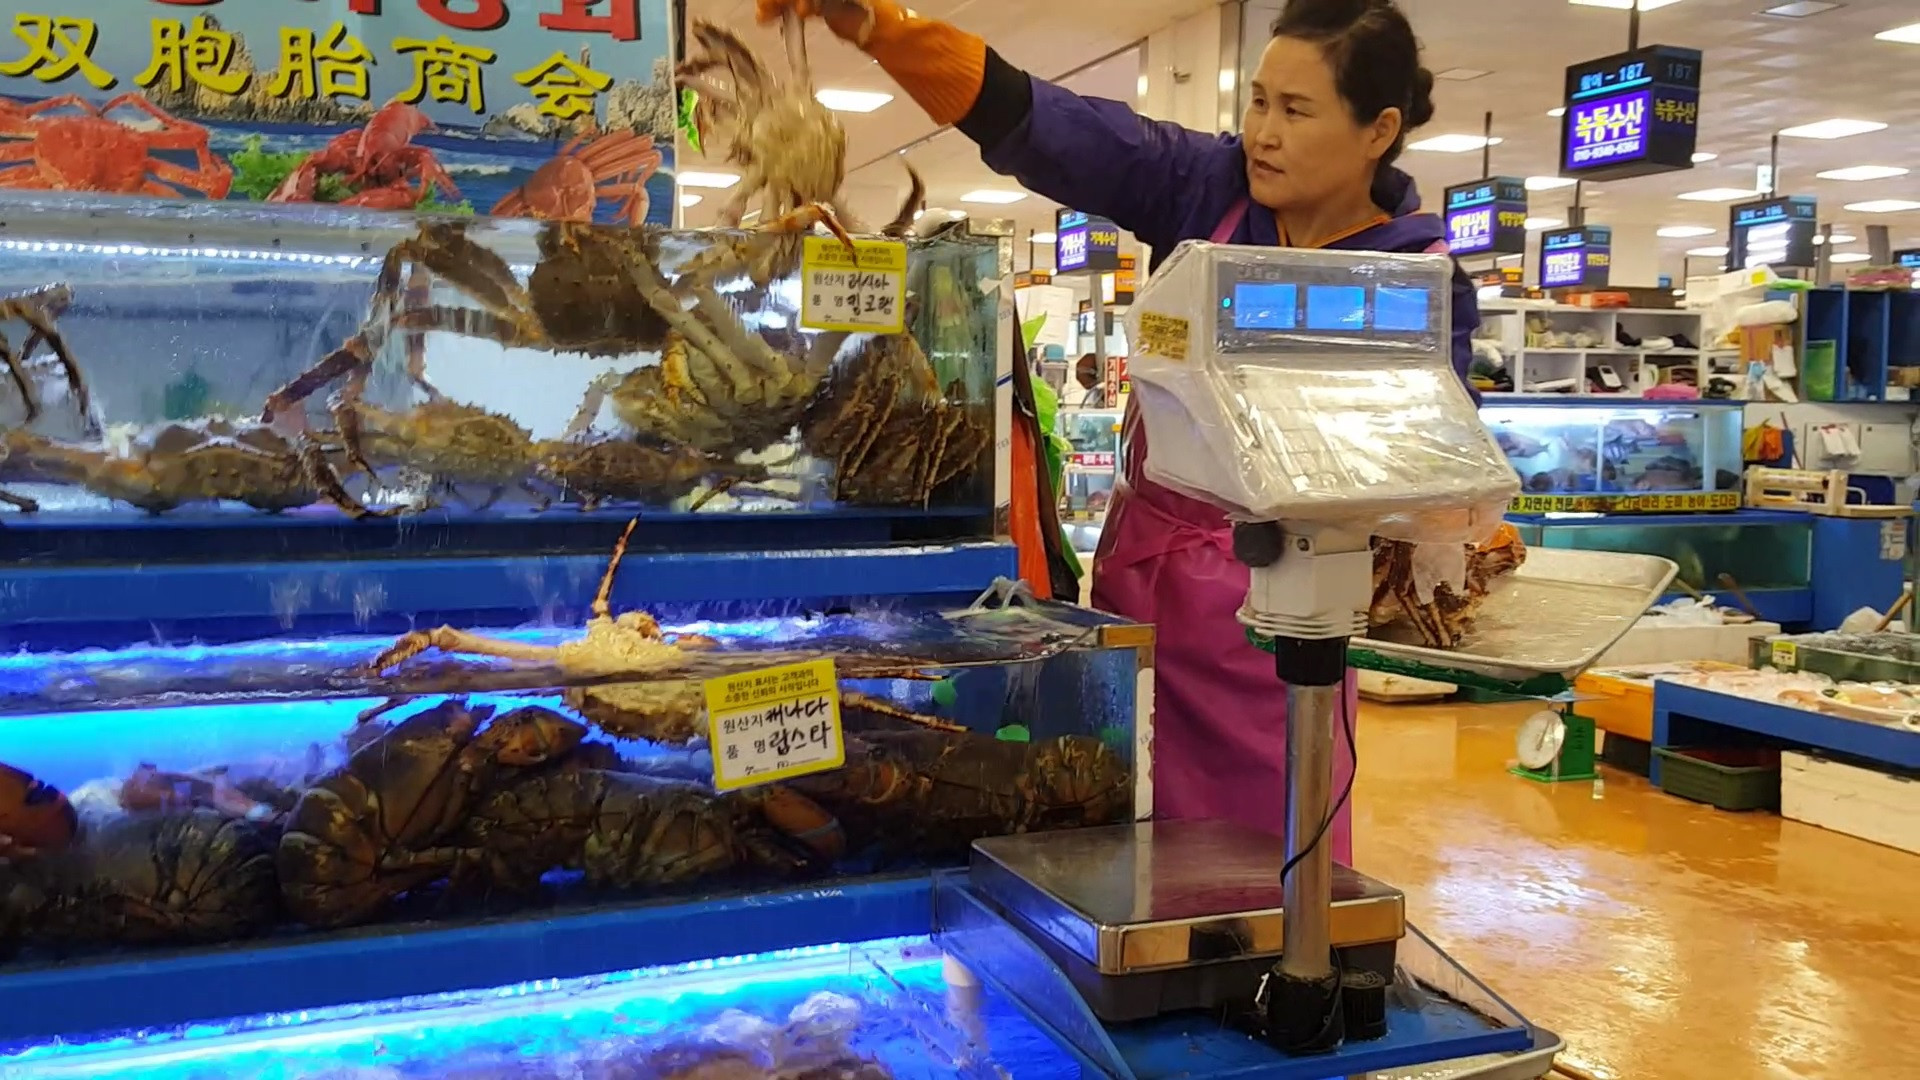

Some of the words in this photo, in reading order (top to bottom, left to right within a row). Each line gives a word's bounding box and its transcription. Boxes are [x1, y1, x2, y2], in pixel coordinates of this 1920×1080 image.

[0, 13, 612, 119] 双胞胎商会
[1619, 62, 1645, 81] 187
[1668, 63, 1691, 80] 187
[1575, 98, 1645, 144] 녹동수산
[1654, 98, 1697, 125] 녹동수산
[814, 272, 844, 286] 원산지
[1523, 497, 1552, 510] 자연산
[1555, 497, 1573, 510] 전문
[723, 713, 763, 734] 원산지
[765, 696, 829, 726] 캐나다
[769, 720, 832, 756] 랍스타
